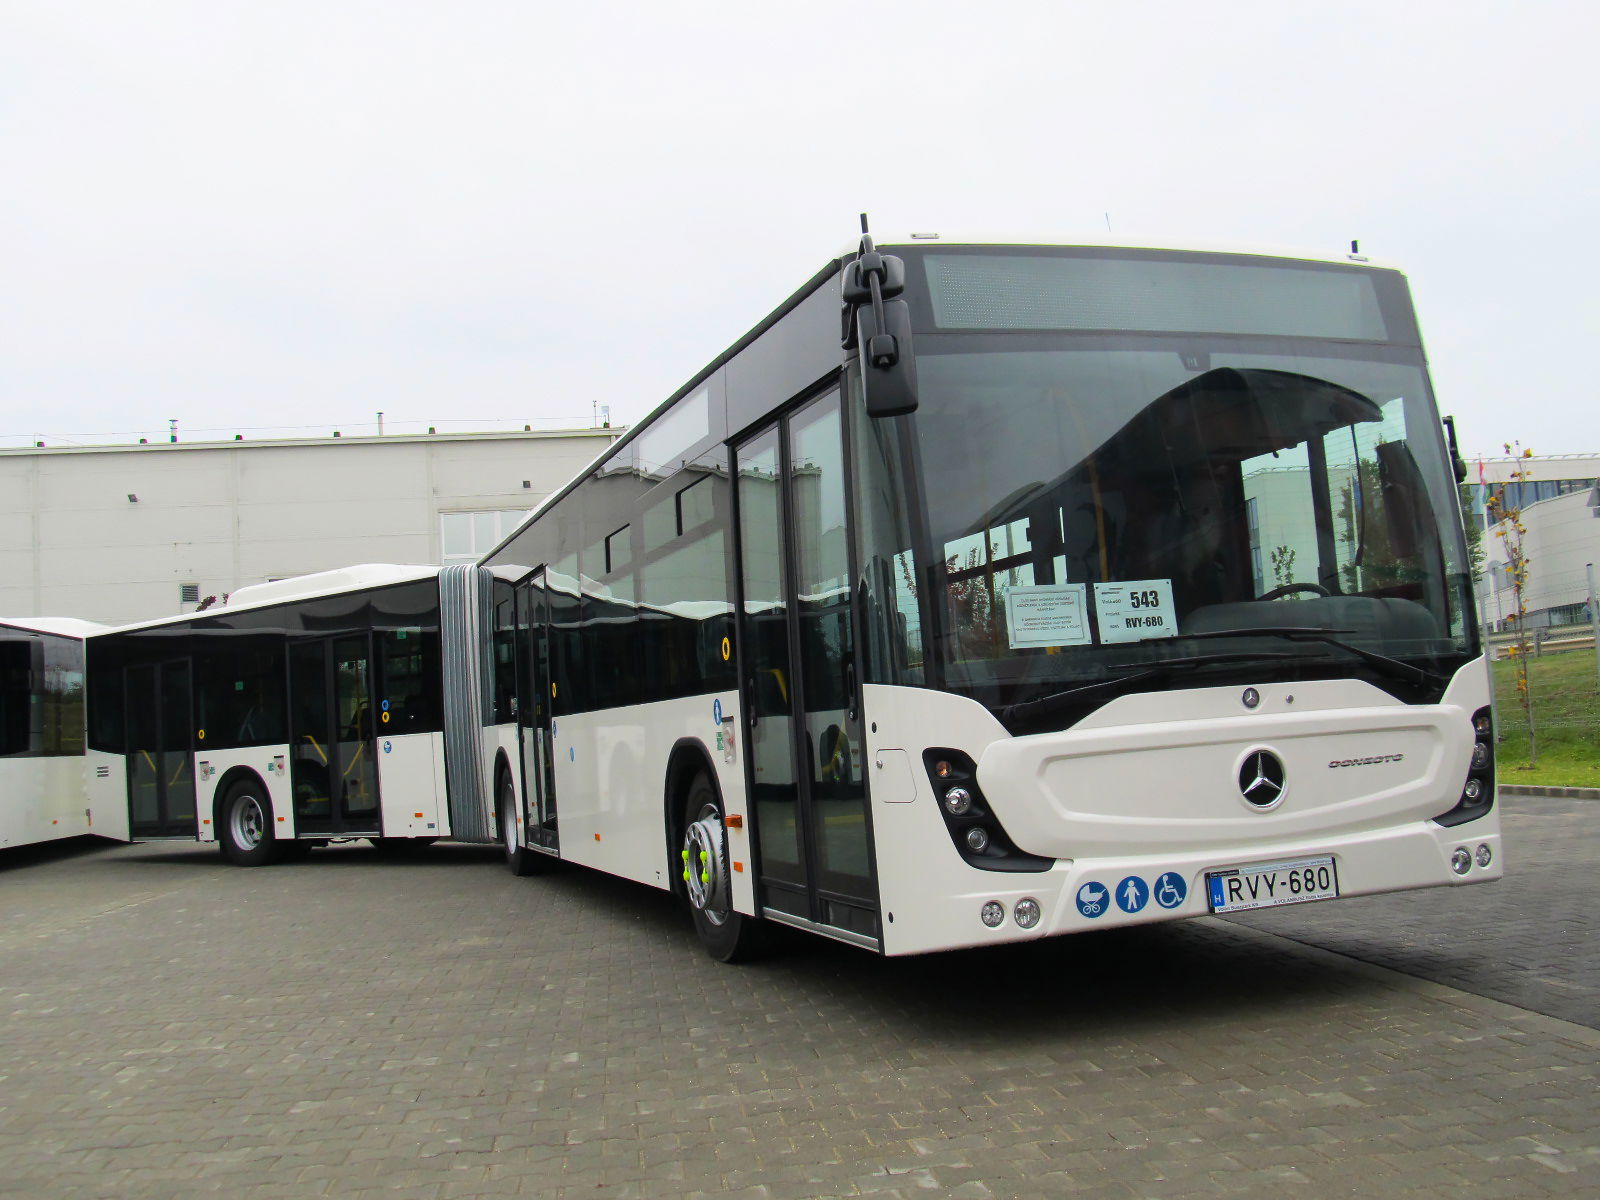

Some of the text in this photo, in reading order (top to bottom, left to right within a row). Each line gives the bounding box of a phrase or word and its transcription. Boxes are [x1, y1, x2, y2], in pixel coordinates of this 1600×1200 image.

[1130, 590, 1160, 609] 543
[1125, 615, 1164, 629] RVY-680
[1227, 866, 1330, 902] RVY-680
[1214, 894, 1222, 904] H
